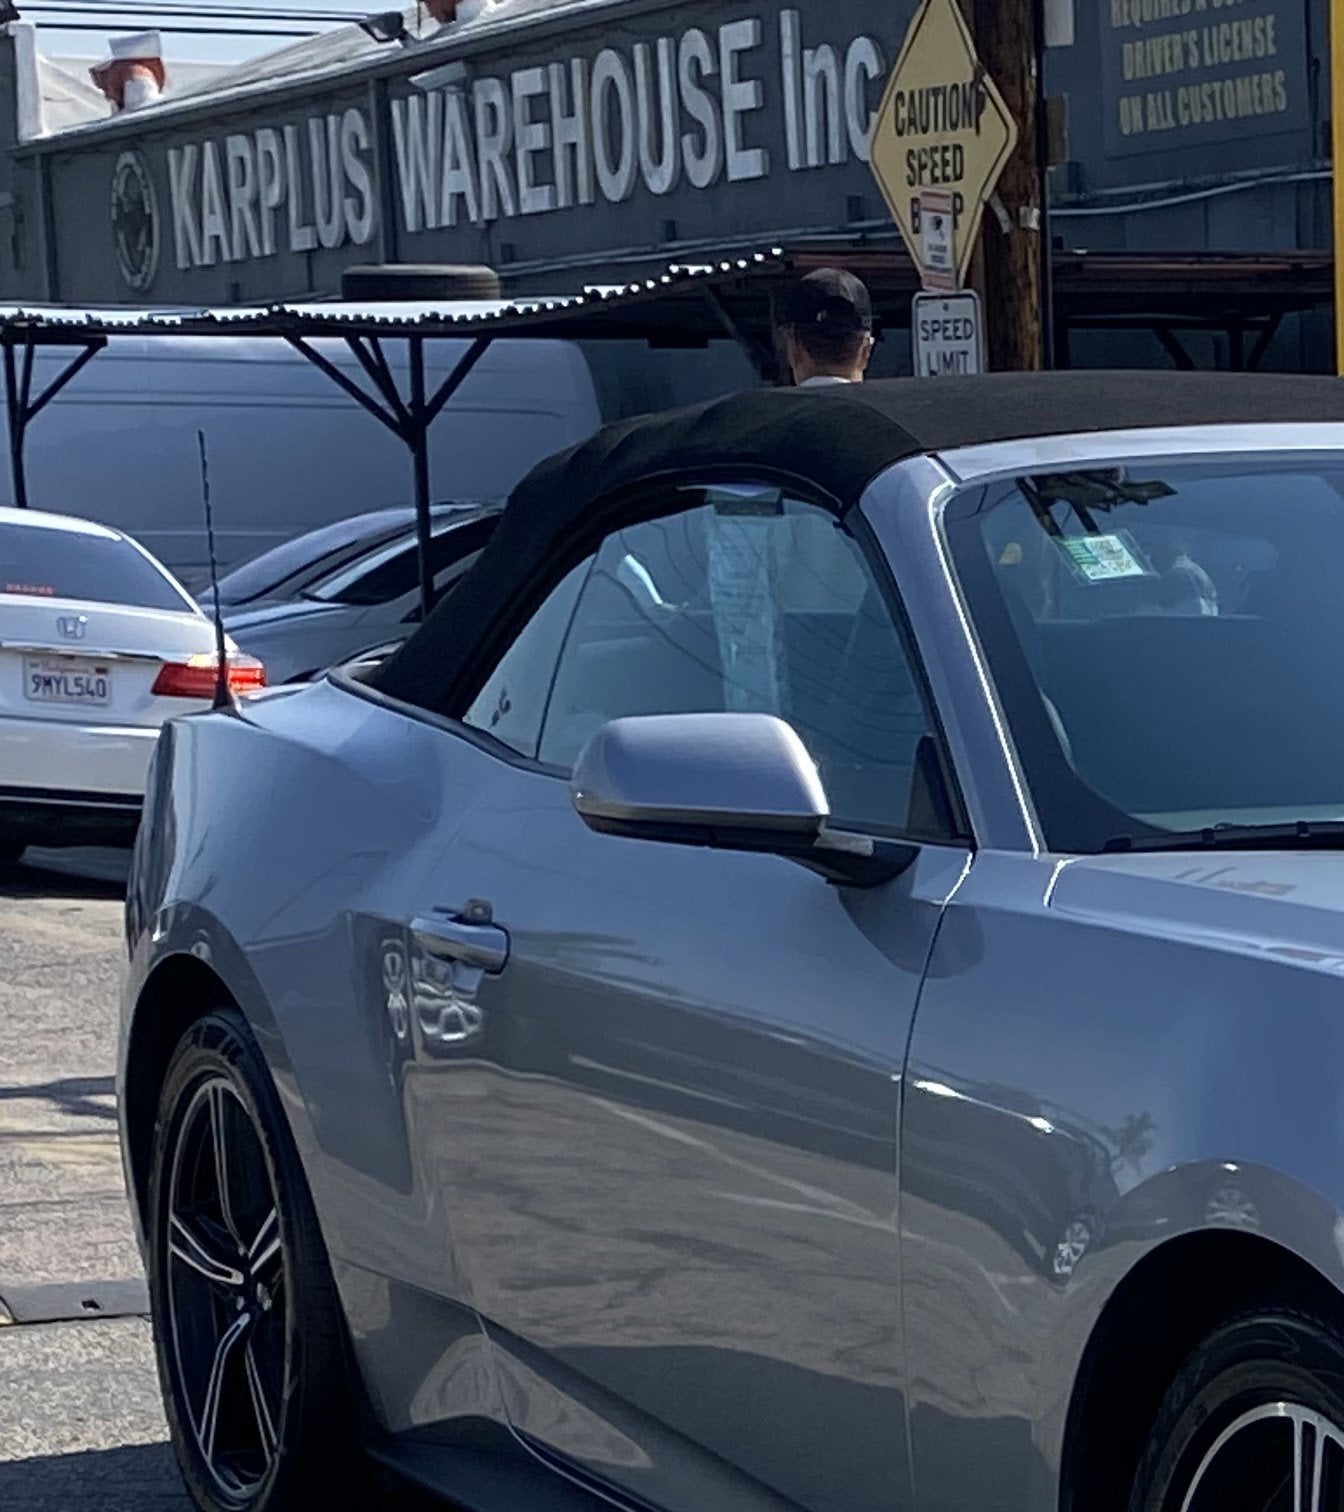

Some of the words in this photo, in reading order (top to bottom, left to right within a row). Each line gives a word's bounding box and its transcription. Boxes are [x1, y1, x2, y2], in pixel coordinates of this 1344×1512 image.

[1122, 29, 1199, 80] DRIVER'S
[1202, 14, 1276, 66] LICENSE
[894, 80, 977, 137] CAUTION
[1119, 95, 1144, 135] ON
[1147, 89, 1176, 131] ALL
[1177, 70, 1287, 126] CUSTOMERS
[167, 109, 376, 269] KARPLUS
[391, 18, 768, 231] WAREHOUSE
[906, 144, 964, 187] SPEED
[911, 191, 964, 235] BP
[920, 318, 973, 342] SPEED
[31, 673, 107, 698] 9MYL540
